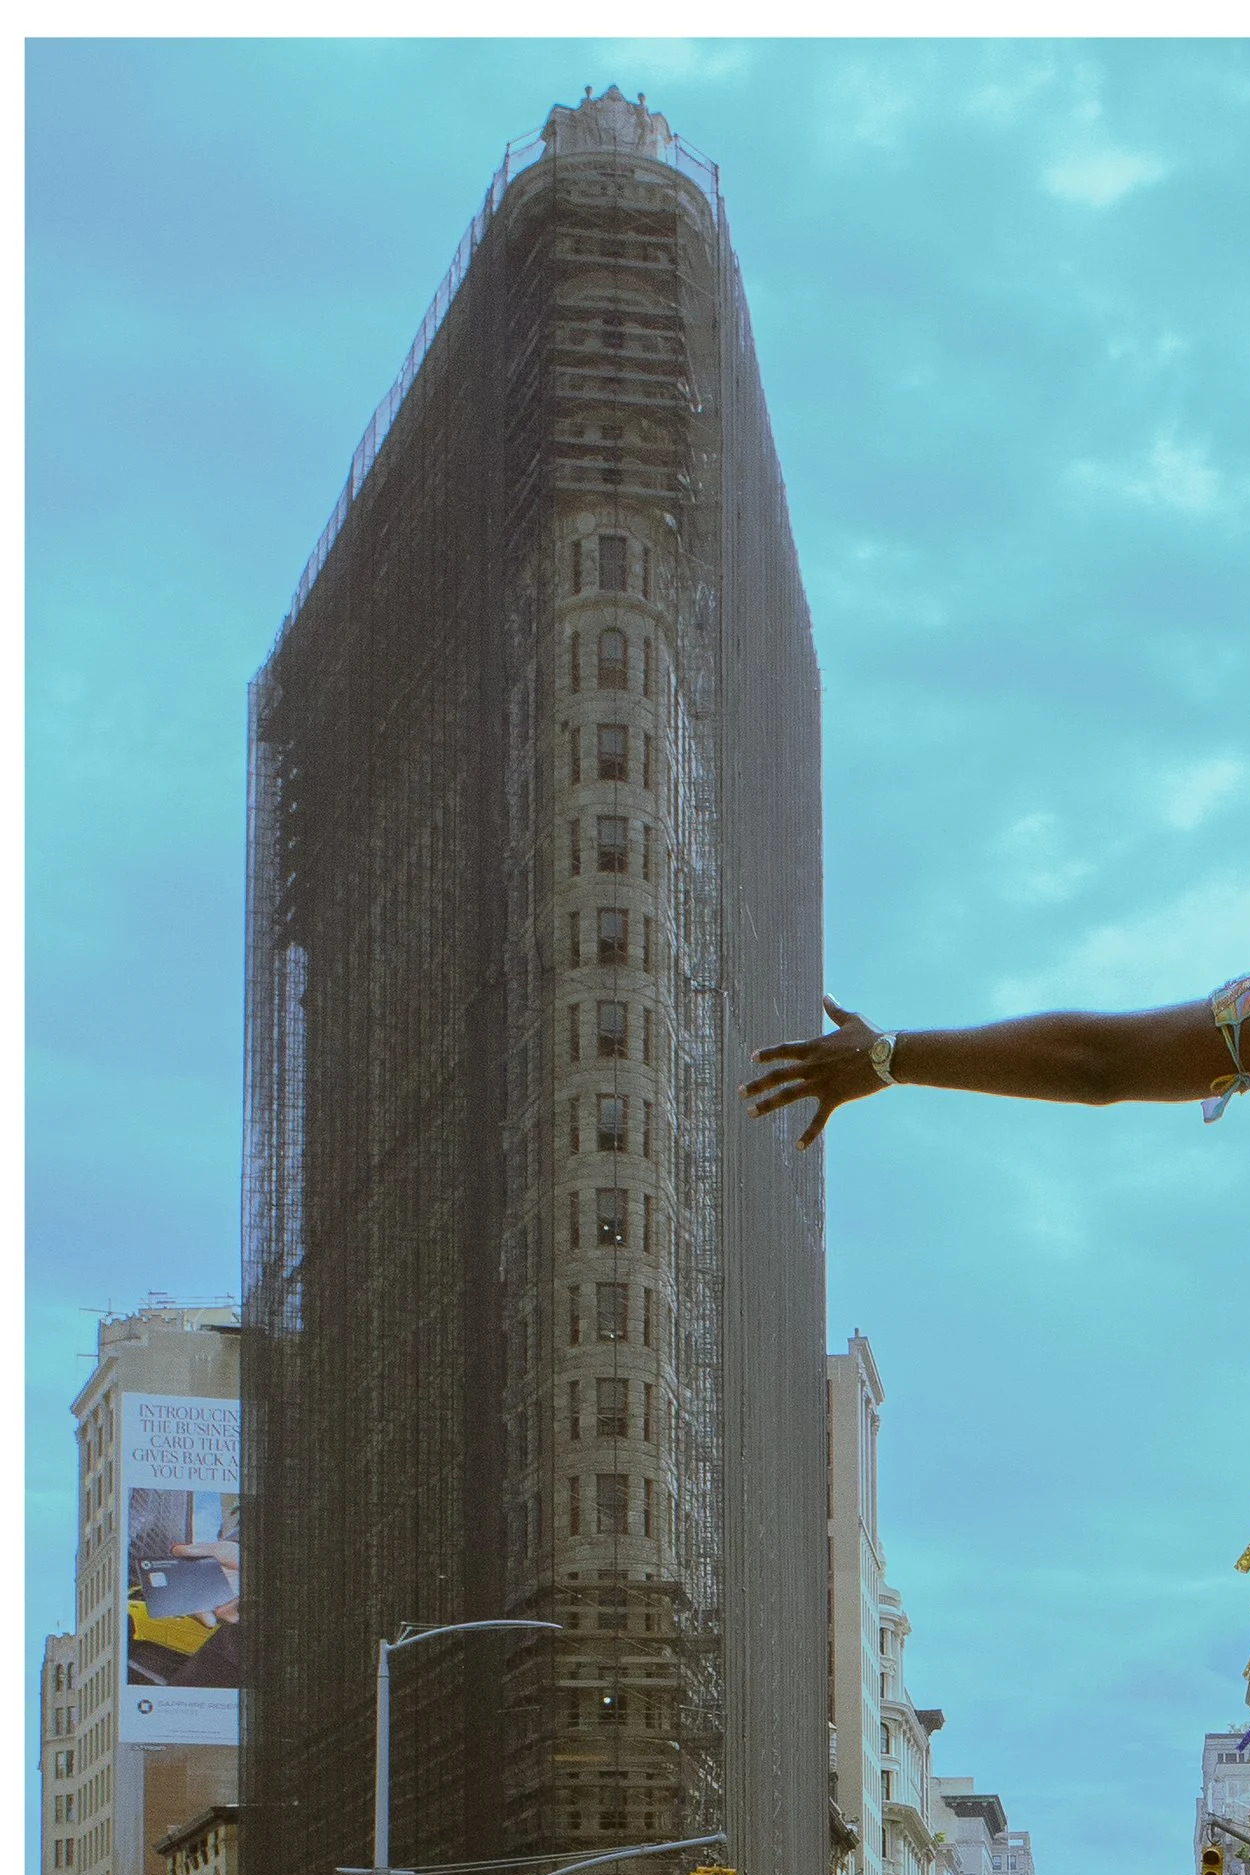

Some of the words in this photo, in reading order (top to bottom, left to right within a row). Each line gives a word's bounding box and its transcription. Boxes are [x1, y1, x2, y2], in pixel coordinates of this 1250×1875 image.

[140, 1404, 240, 1423] INTRODUCIN
[141, 1419, 171, 1434] THE
[176, 1421, 241, 1437] BUSINES
[150, 1435, 194, 1450] CARD
[200, 1438, 240, 1453] THAT
[132, 1448, 179, 1464] GIVES
[183, 1451, 224, 1466] BACK
[150, 1464, 184, 1479] YOU
[188, 1467, 218, 1481] PUT
[222, 1468, 239, 1482] IN
